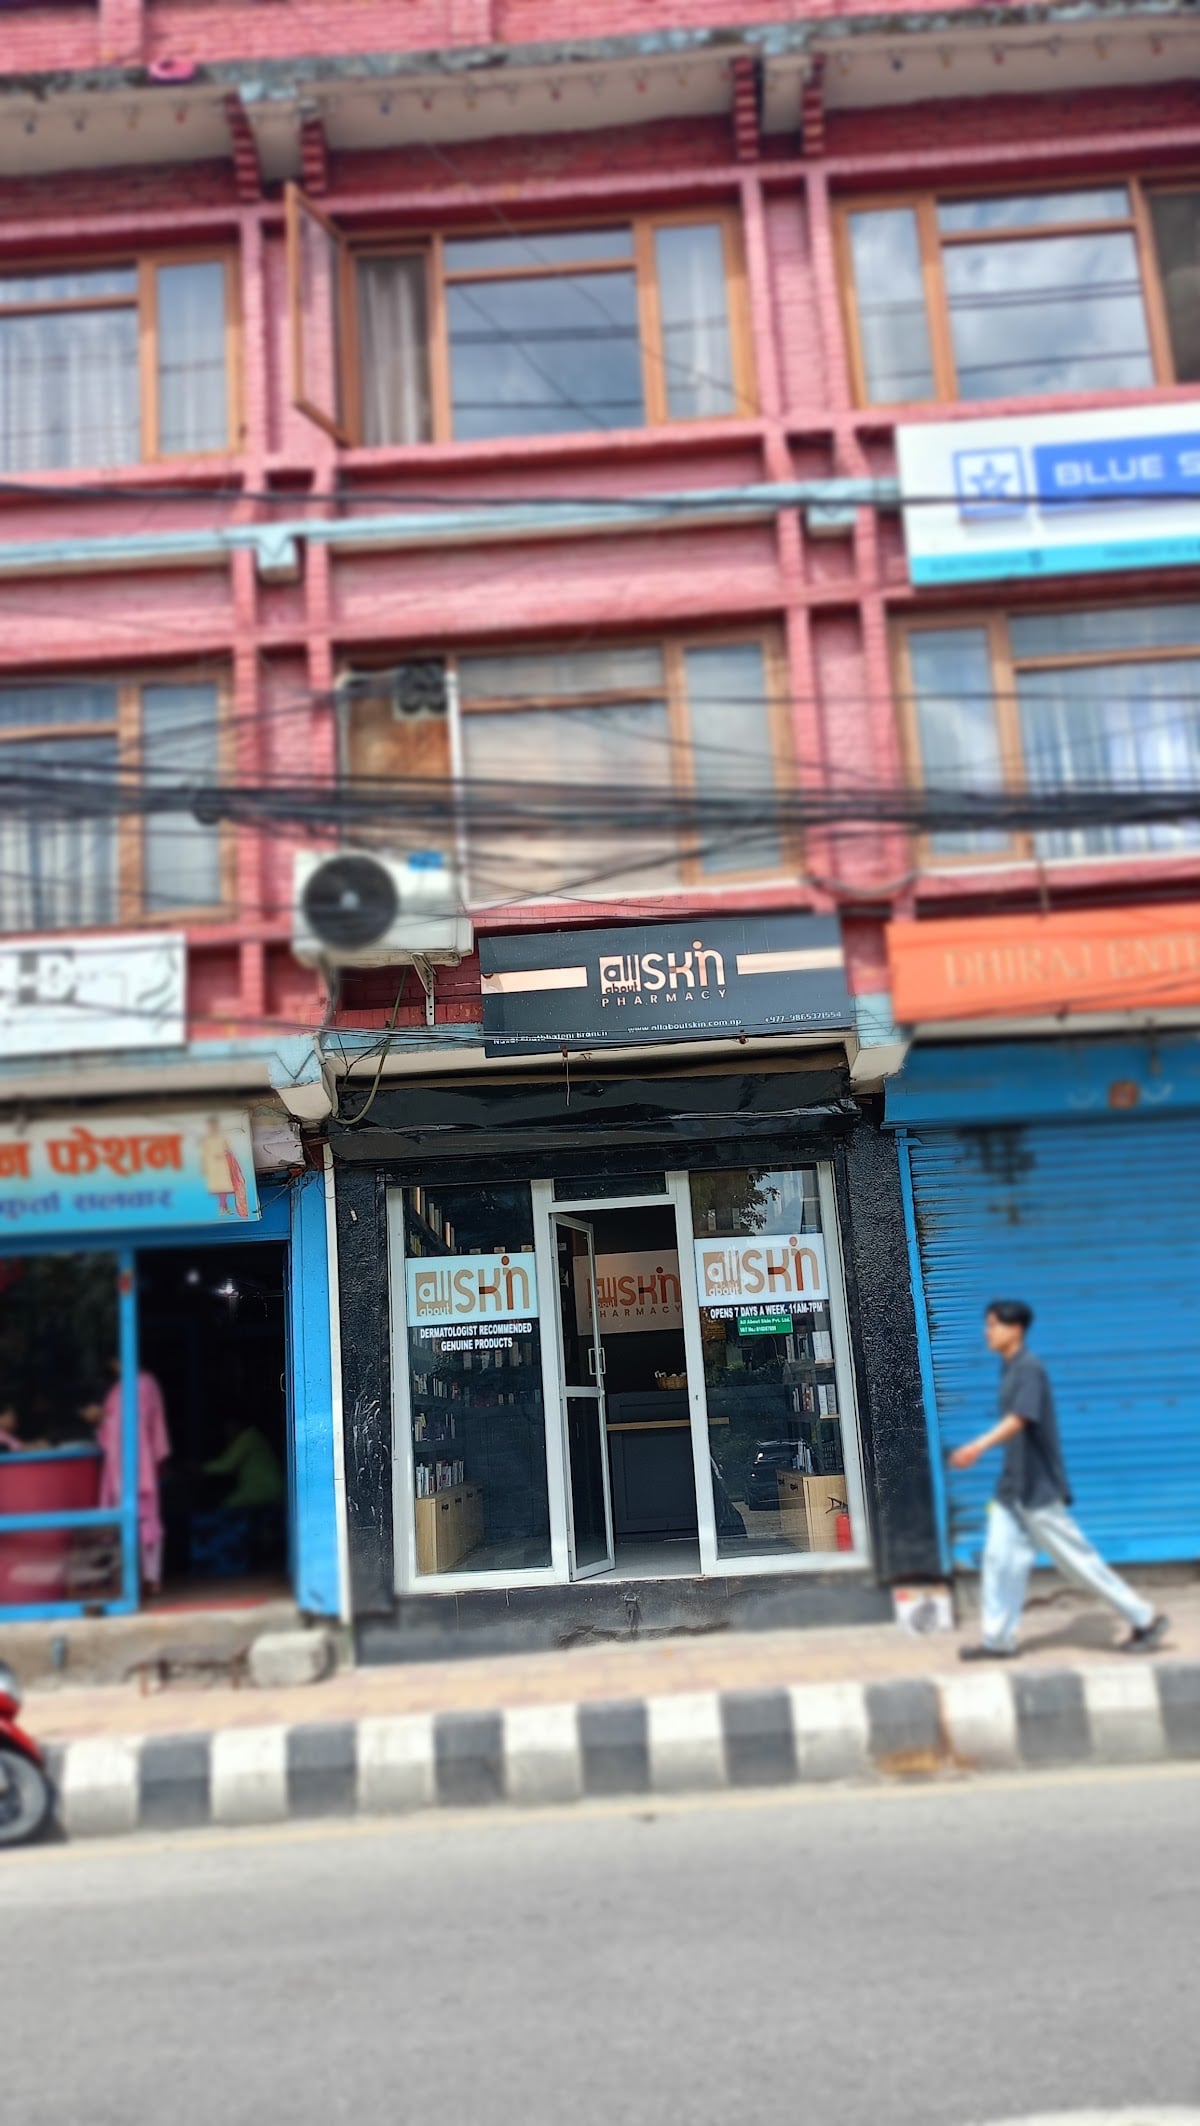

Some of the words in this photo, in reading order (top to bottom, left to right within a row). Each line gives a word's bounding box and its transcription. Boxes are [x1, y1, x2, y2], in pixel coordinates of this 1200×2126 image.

[1054, 455, 1162, 487] BLUE
[945, 943, 1092, 987] DHIRAJ
[605, 981, 639, 994] about
[601, 988, 727, 1008] PHARMACY
[708, 1284, 740, 1297] about
[419, 1303, 450, 1317] about
[710, 1307, 734, 1319] OPENS
[735, 1307, 739, 1317] 7
[740, 1305, 758, 1317] DAYS
[759, 1305, 765, 1315] A
[789, 1302, 823, 1314] 11AM-7PM
[420, 1326, 478, 1339] DERMATOLOGIST
[479, 1322, 533, 1336] RECOMMENDED
[441, 1339, 474, 1352] GENUINE
[474, 1337, 513, 1350] PRODUCTS
